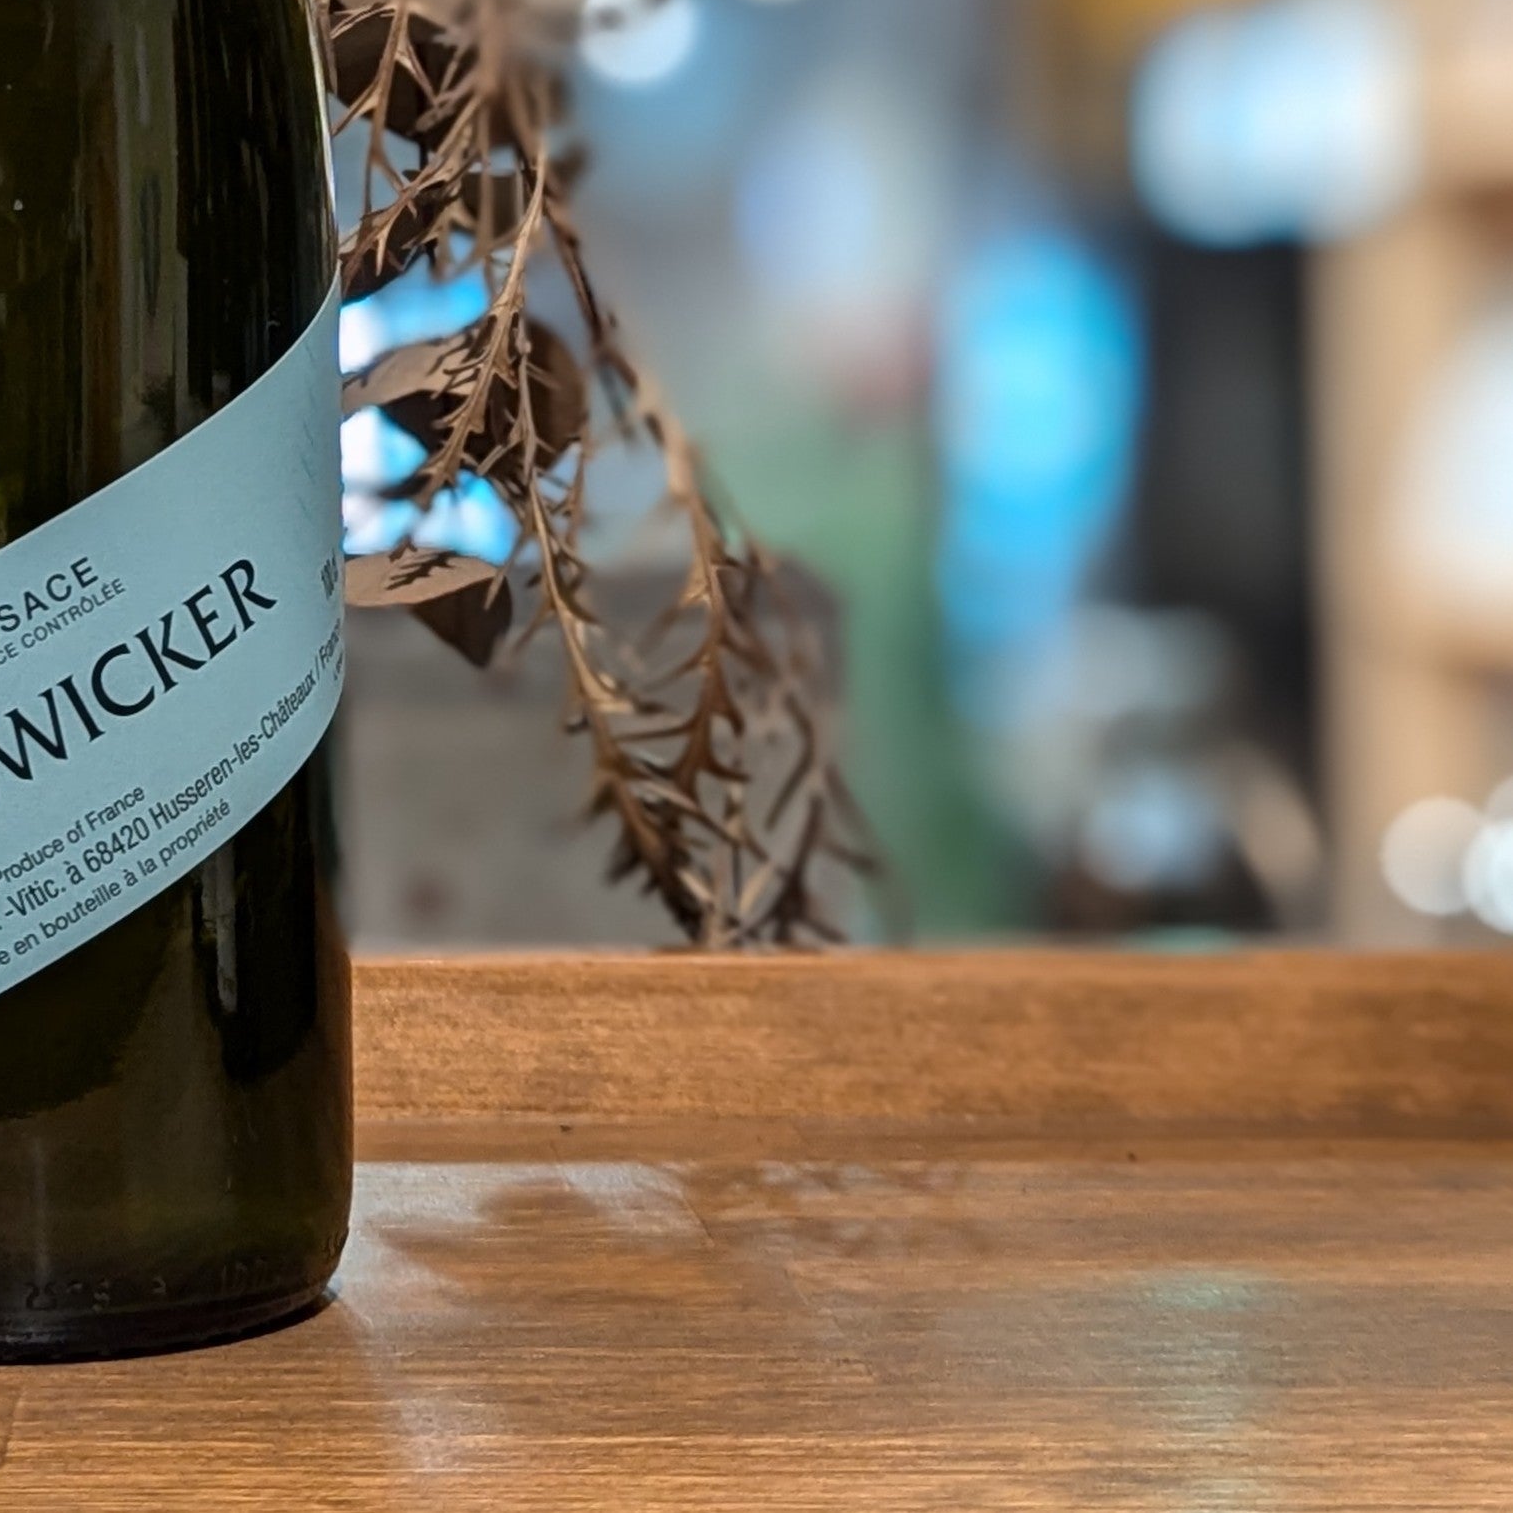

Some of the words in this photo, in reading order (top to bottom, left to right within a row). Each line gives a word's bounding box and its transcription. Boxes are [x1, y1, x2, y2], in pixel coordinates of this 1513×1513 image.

[20, 578, 126, 649] CONTRÔLÉE
[66, 859, 85, 885] à
[83, 816, 151, 873] 68420
[149, 668, 317, 831] Husseren-les-Châteaux
[66, 820, 87, 844] of
[85, 786, 146, 832] France
[13, 933, 41, 956] en
[39, 879, 122, 940] bouteille
[123, 868, 139, 887] à
[137, 857, 158, 877] la
[159, 797, 231, 867] propriété
